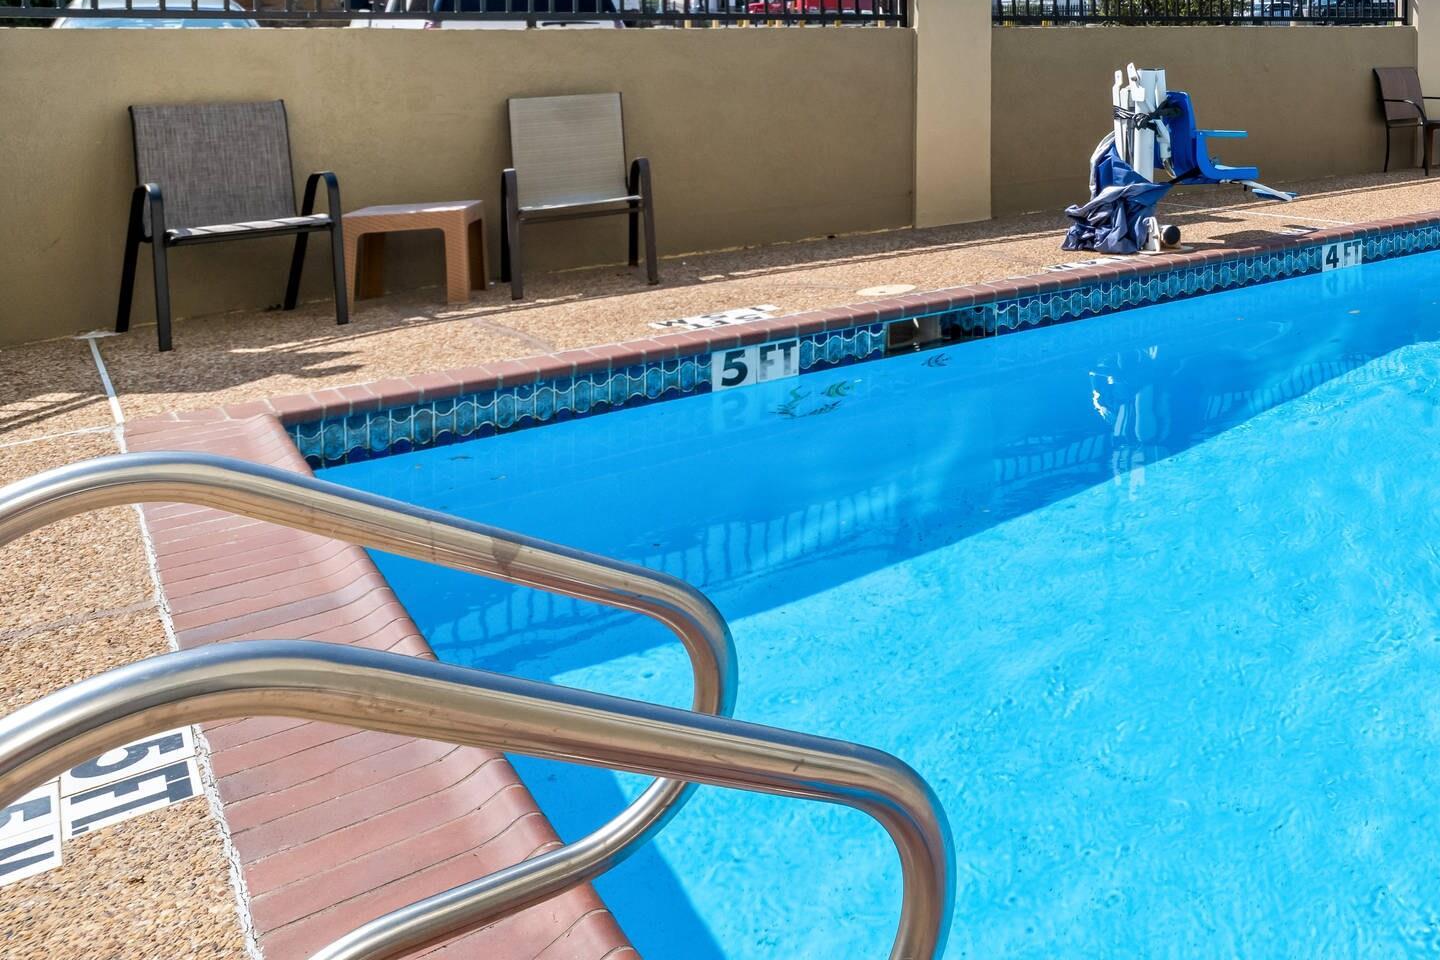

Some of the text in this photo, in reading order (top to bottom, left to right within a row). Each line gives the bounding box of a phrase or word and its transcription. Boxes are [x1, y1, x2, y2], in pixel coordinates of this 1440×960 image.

[1325, 241, 1361, 268] 4 FT
[721, 349, 749, 387] 5
